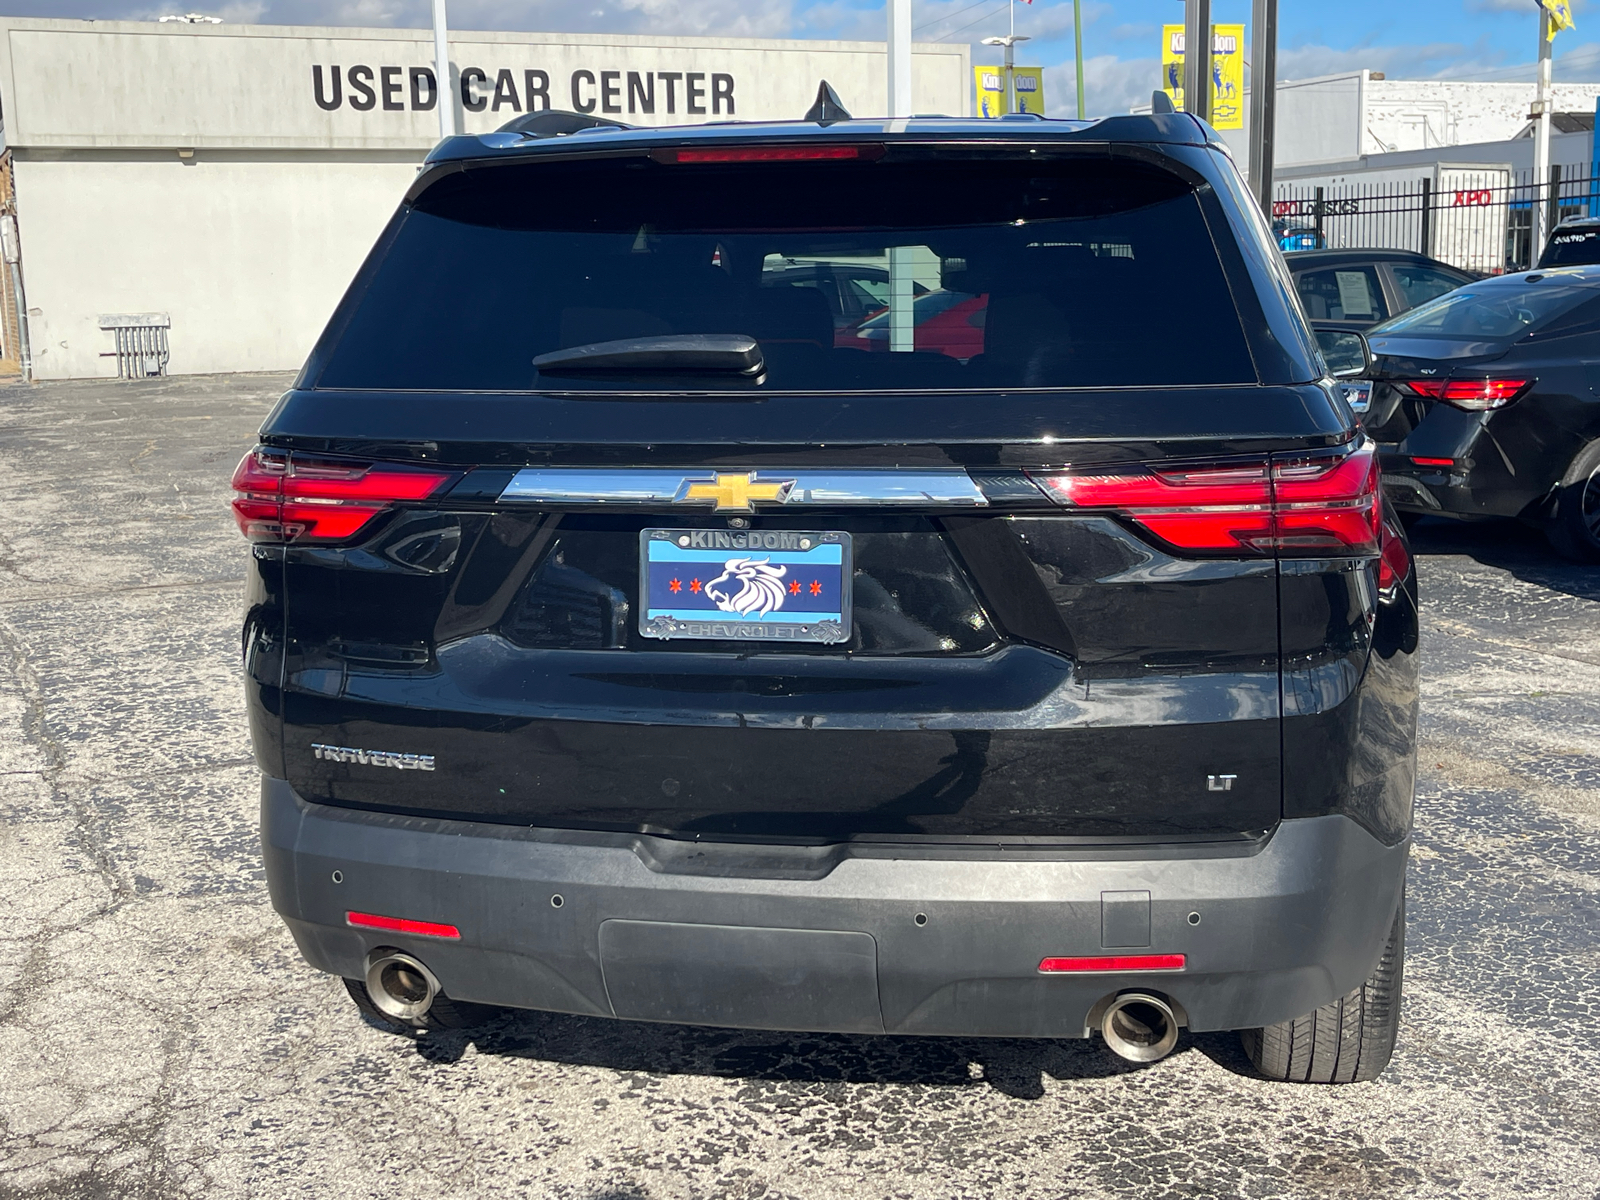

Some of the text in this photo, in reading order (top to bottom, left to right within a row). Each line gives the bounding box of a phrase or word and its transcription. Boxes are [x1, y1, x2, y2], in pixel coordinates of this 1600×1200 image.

[312, 64, 736, 115] USED CAR CENTER
[982, 73, 1004, 91] King
[1452, 188, 1491, 206] XPO
[690, 531, 798, 549] KINGDOM
[687, 624, 801, 639] CHEVROLET
[311, 743, 435, 771] TRAVERSE
[1207, 774, 1237, 791] LT
